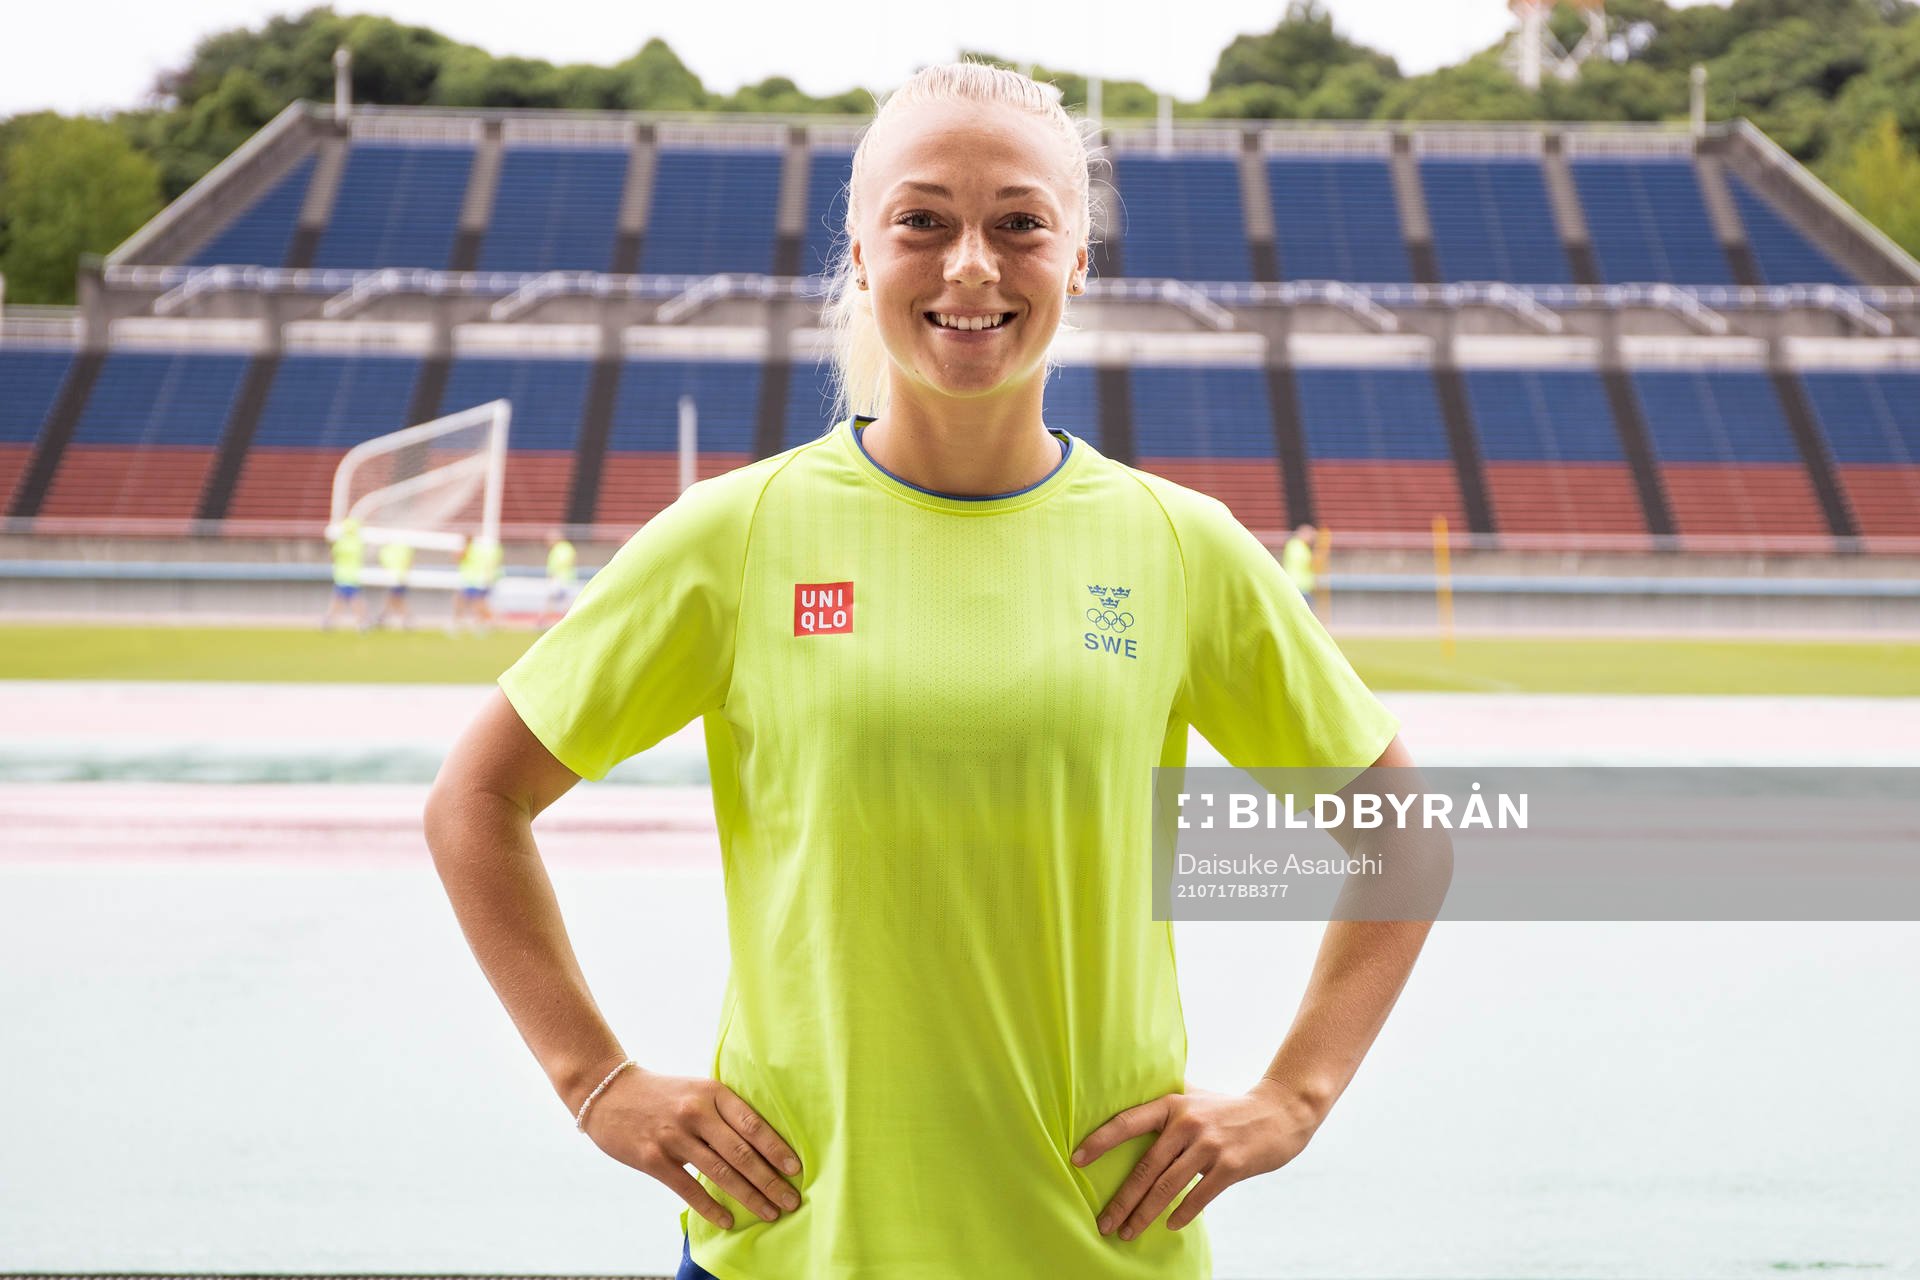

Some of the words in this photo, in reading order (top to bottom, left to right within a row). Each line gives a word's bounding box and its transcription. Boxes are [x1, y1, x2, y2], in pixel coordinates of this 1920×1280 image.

[801, 588, 843, 608] UNI
[800, 610, 847, 632] QLO
[1084, 632, 1137, 659] SWE
